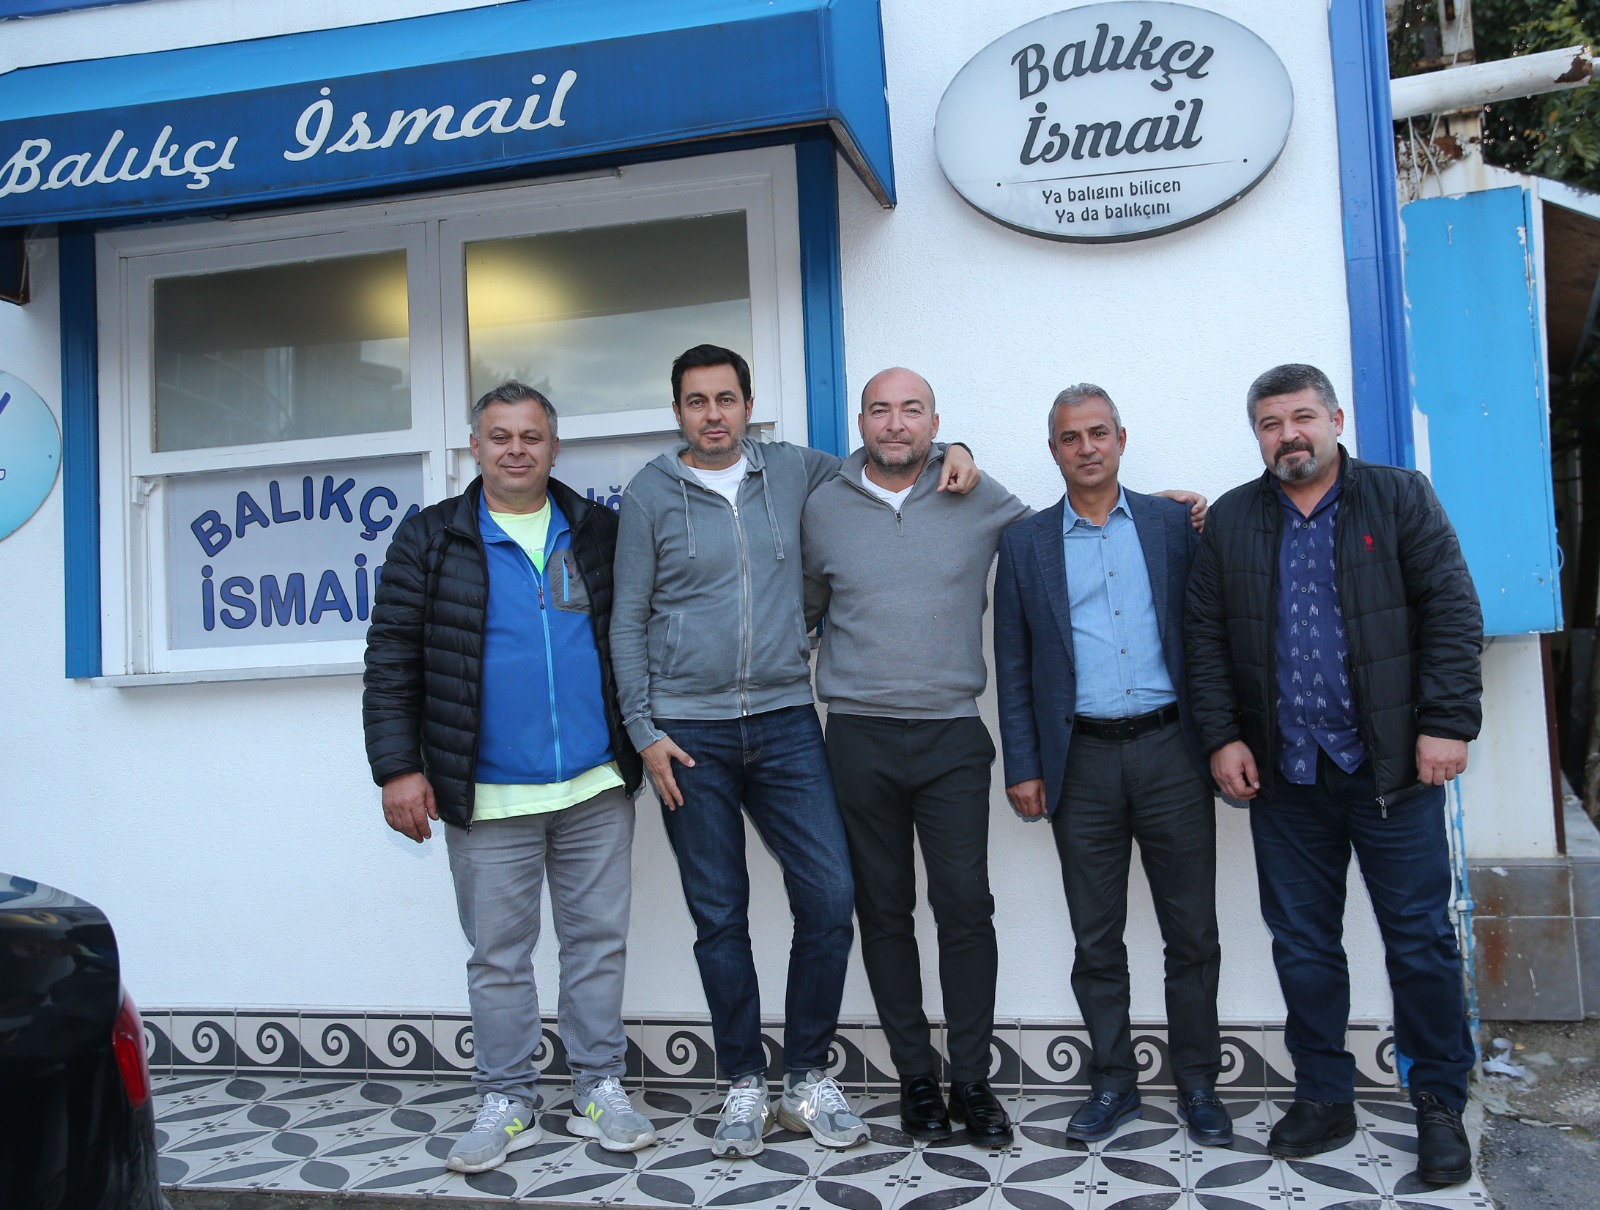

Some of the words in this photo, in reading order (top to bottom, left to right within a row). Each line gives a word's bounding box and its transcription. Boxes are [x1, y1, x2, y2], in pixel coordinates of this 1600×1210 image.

[1011, 20, 1214, 99] Balıkçı
[0, 125, 239, 198] Balıkçı
[283, 70, 577, 162] İsmail
[1042, 189, 1062, 204] Ya
[1130, 180, 1181, 196] bilicen
[1055, 209, 1075, 224] Ya
[1081, 207, 1099, 221] da
[1105, 202, 1171, 219] balıkçını
[201, 553, 383, 632] İSMAİ
